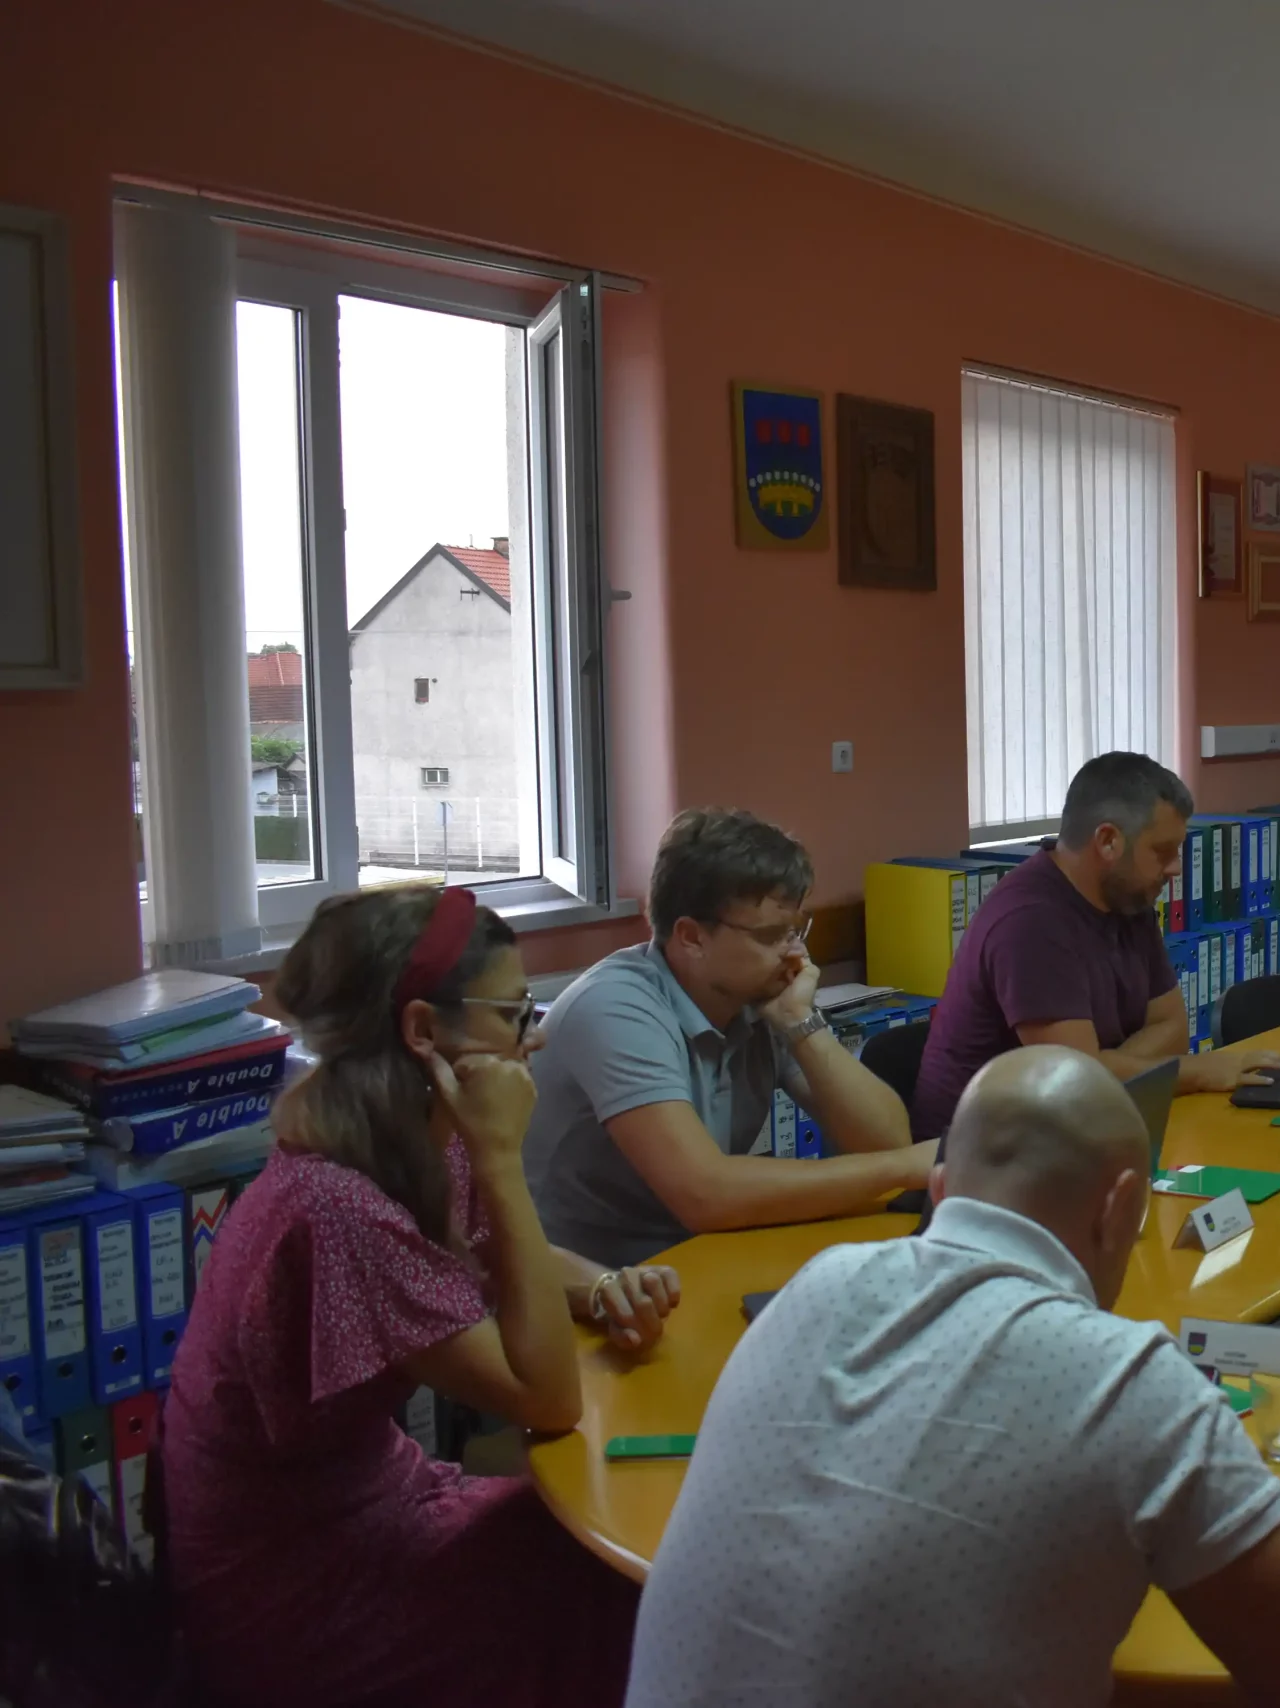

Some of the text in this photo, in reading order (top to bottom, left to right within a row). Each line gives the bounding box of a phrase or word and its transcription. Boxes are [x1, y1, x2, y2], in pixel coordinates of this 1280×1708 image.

[187, 1079, 200, 1094] A
[207, 1063, 274, 1088] Double
[172, 1094, 271, 1140] Double A
